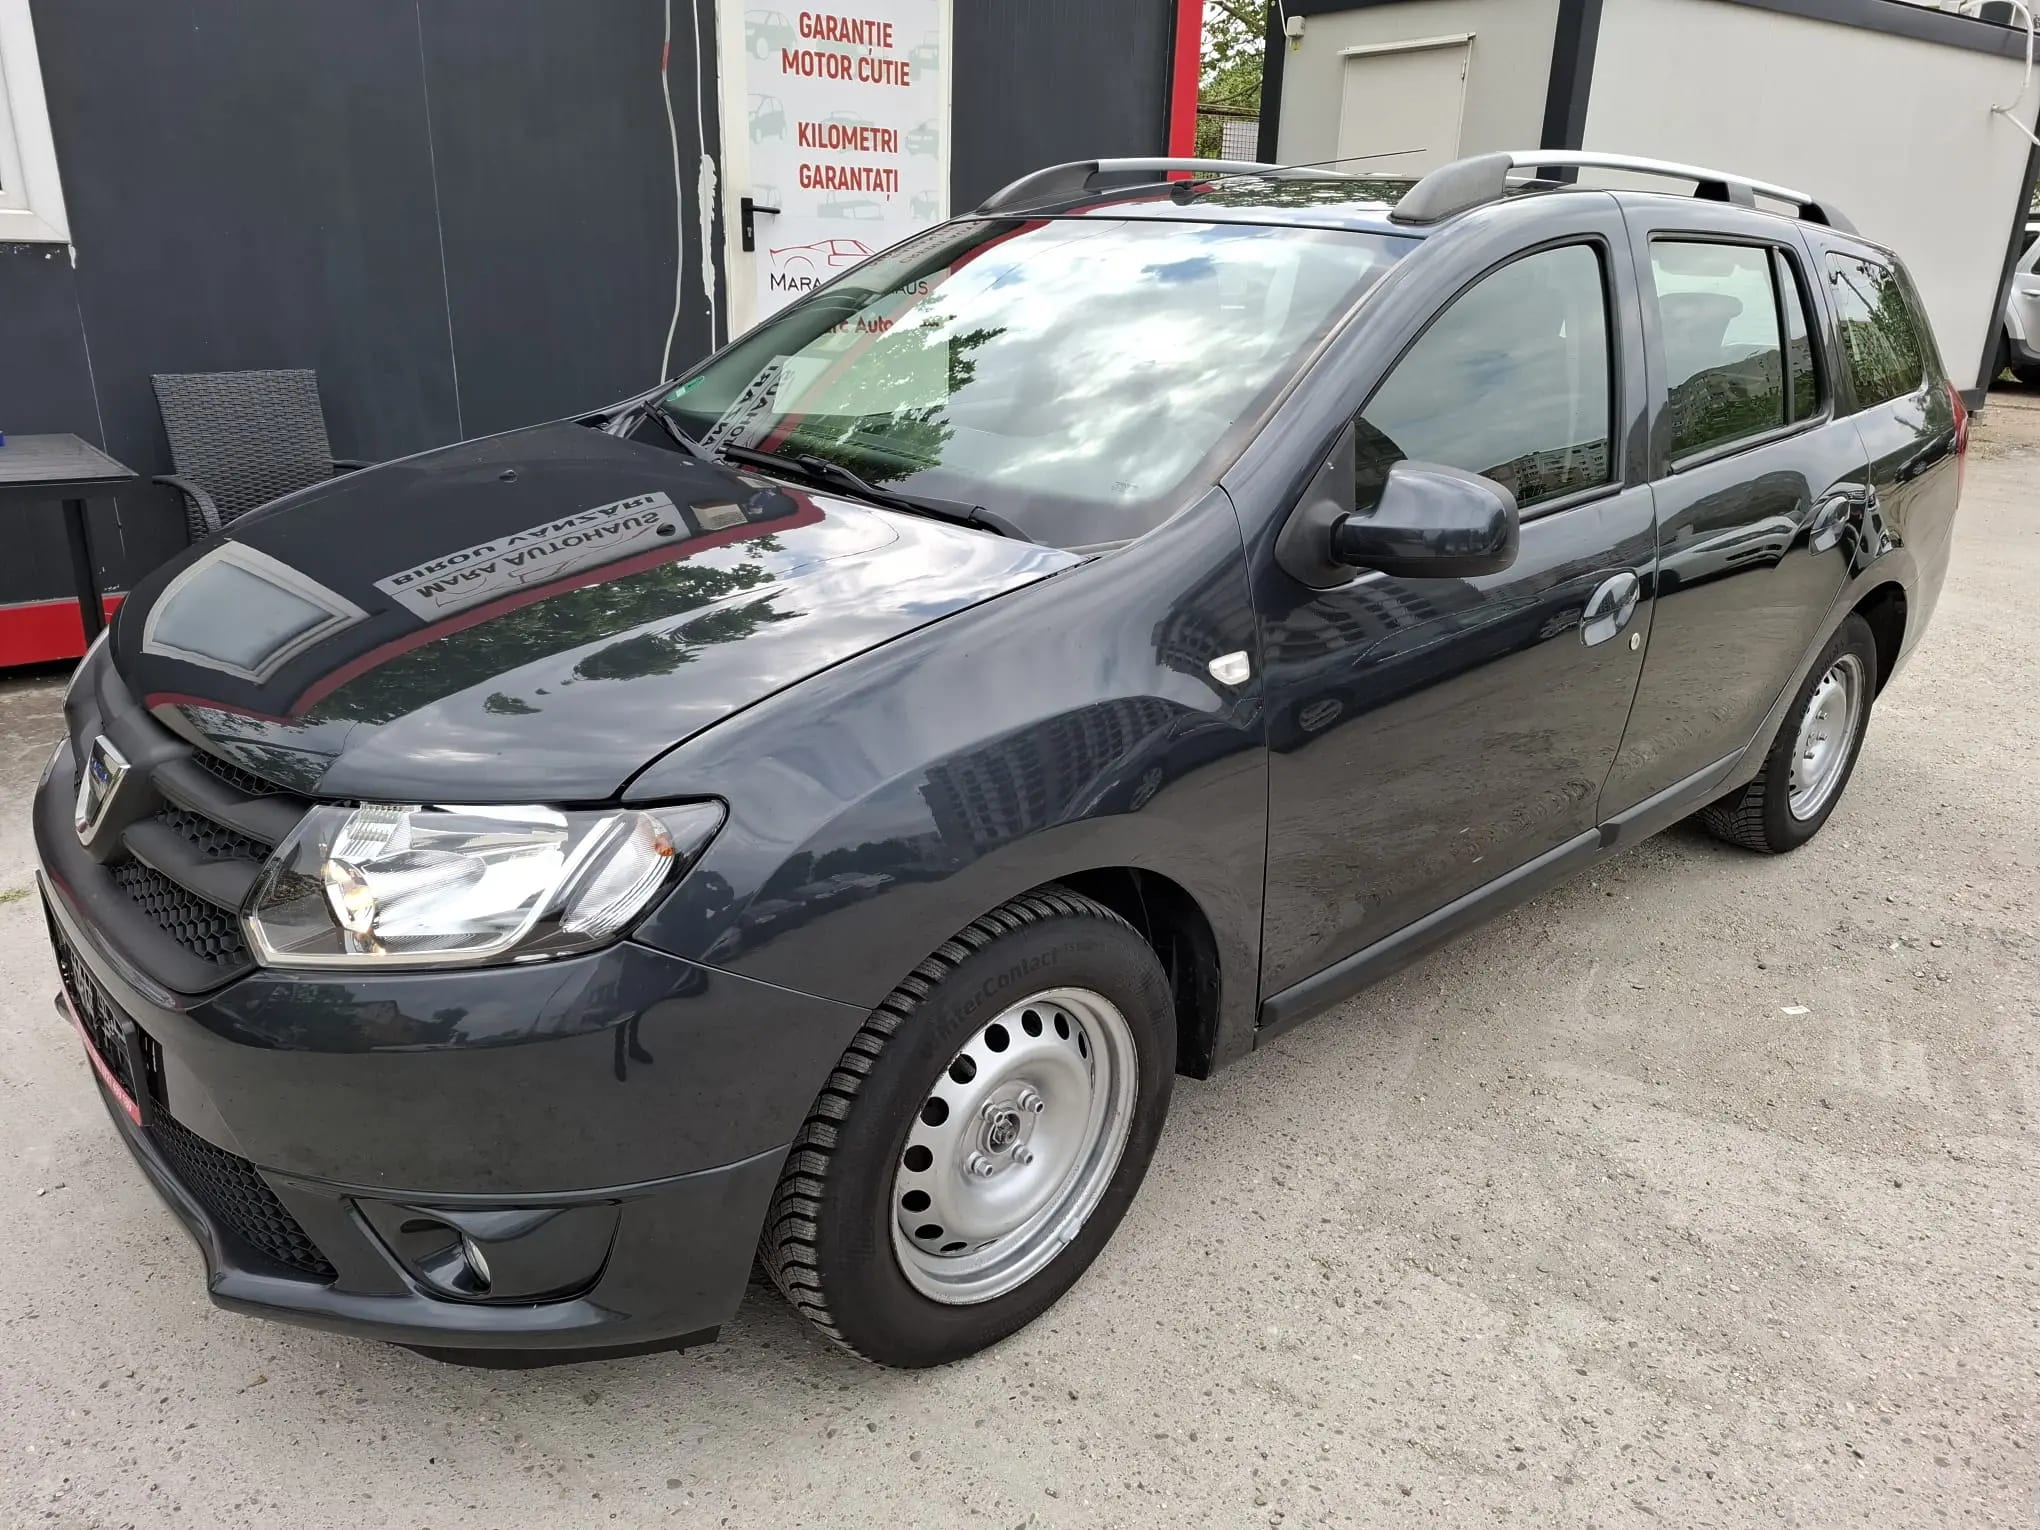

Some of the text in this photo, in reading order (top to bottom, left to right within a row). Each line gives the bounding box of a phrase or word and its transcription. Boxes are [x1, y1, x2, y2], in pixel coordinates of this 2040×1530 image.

[799, 11, 893, 55] GARANȚIE
[781, 48, 910, 86] MOTOR CUTIE
[798, 121, 898, 153] KILOMETRI
[799, 163, 898, 201] GARANTAȚI
